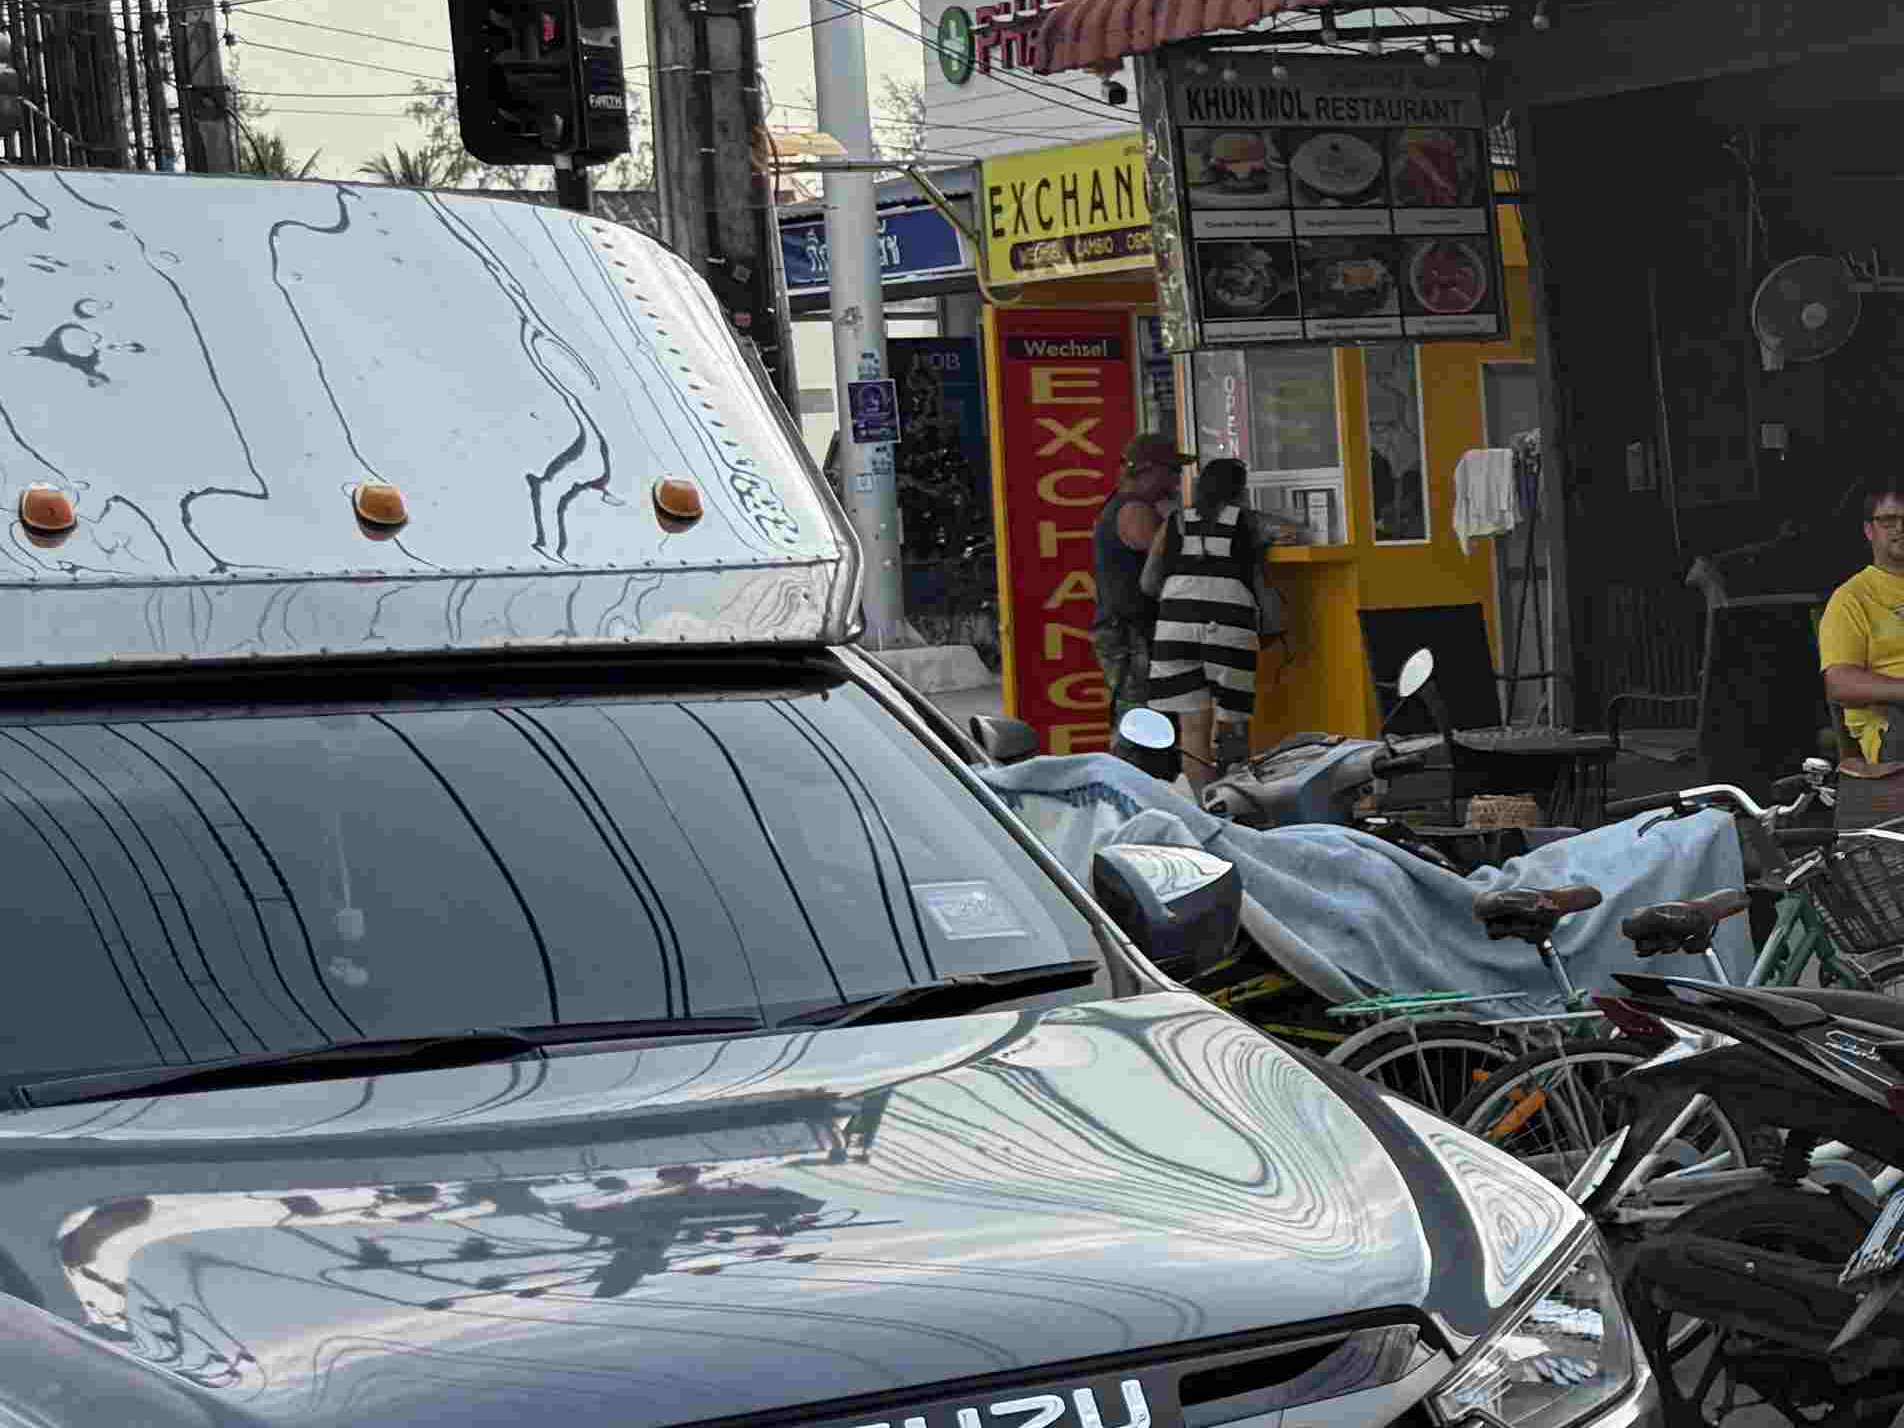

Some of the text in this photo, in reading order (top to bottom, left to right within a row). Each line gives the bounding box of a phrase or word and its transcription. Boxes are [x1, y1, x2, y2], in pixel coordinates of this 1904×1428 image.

[1185, 85, 1465, 126] KHUN MOL RESTAURANT
[988, 161, 1152, 240] EXCHAN
[1023, 337, 1109, 359] Wechsel
